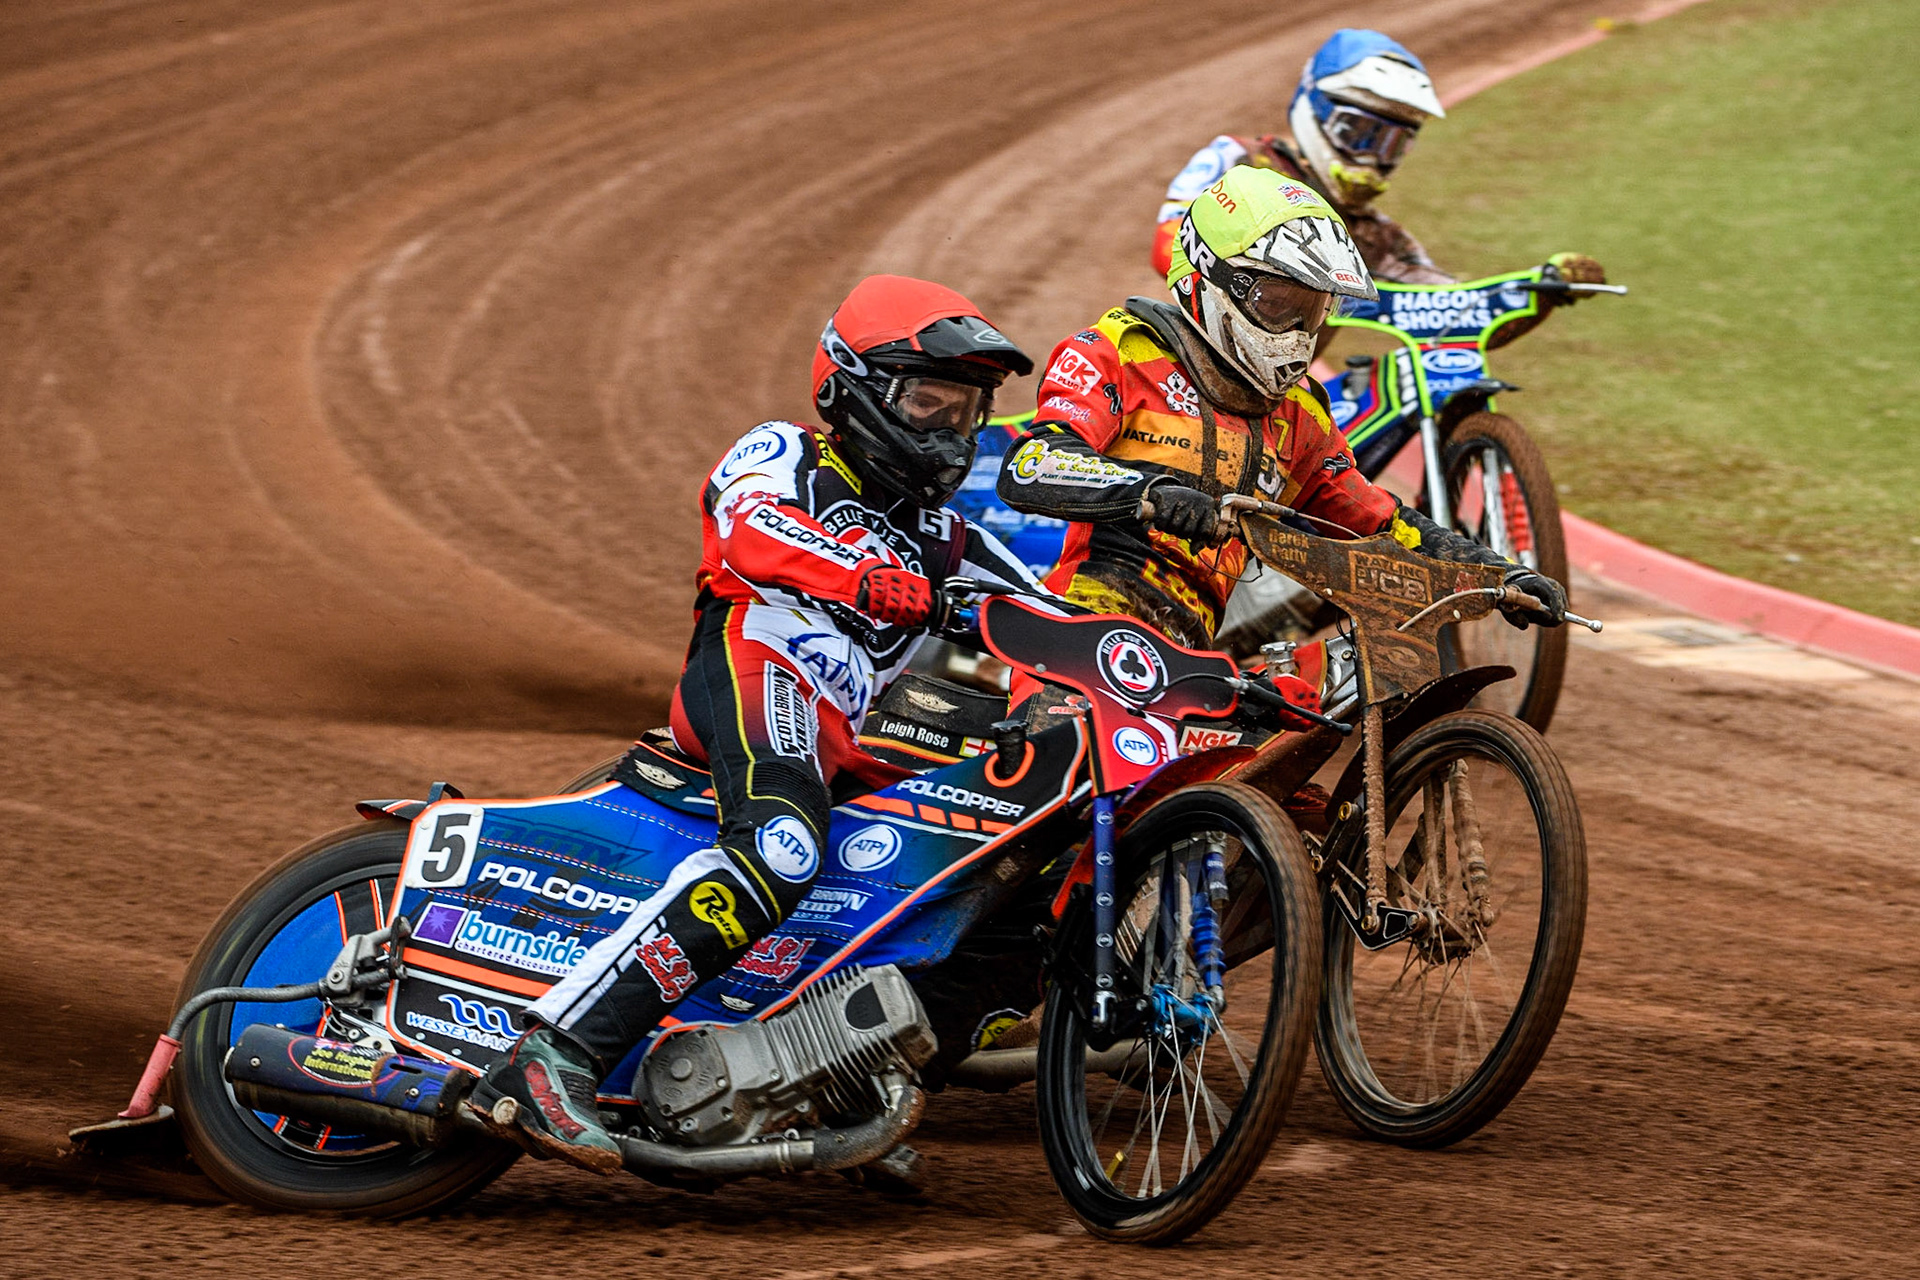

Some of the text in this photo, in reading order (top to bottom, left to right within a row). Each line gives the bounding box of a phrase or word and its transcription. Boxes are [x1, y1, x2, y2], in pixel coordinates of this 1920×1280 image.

[1210, 180, 1237, 214] Dan
[1336, 272, 1362, 285] BELL
[1392, 290, 1489, 311] HAGON
[1393, 309, 1492, 330] SHOCKS
[1057, 352, 1096, 385] NGK
[1058, 377, 1085, 393] PLUGS
[1273, 418, 1291, 452] 7
[733, 441, 772, 463] ATPI
[823, 508, 866, 534] BELLE
[924, 512, 942, 538] 5
[1355, 552, 1426, 579] WATLING
[1356, 566, 1427, 602] JCB
[774, 665, 797, 710] BROWN
[775, 710, 803, 755] SCOTT
[880, 719, 950, 749] Leigh Rose
[1184, 729, 1236, 748] NGK
[1123, 740, 1150, 753] ATPI
[896, 779, 1026, 818] POLCOPPER
[421, 813, 472, 883] 5
[769, 829, 810, 866] ATPI
[850, 839, 888, 855] ATPI
[477, 861, 641, 915] POLCOPP
[809, 888, 869, 911] BROWN
[457, 942, 513, 963] chartered
[461, 912, 587, 968] burnside
[406, 1011, 516, 1052] WESSEXMAR
[311, 1048, 334, 1060] Joe
[304, 1055, 374, 1080] Internationa
